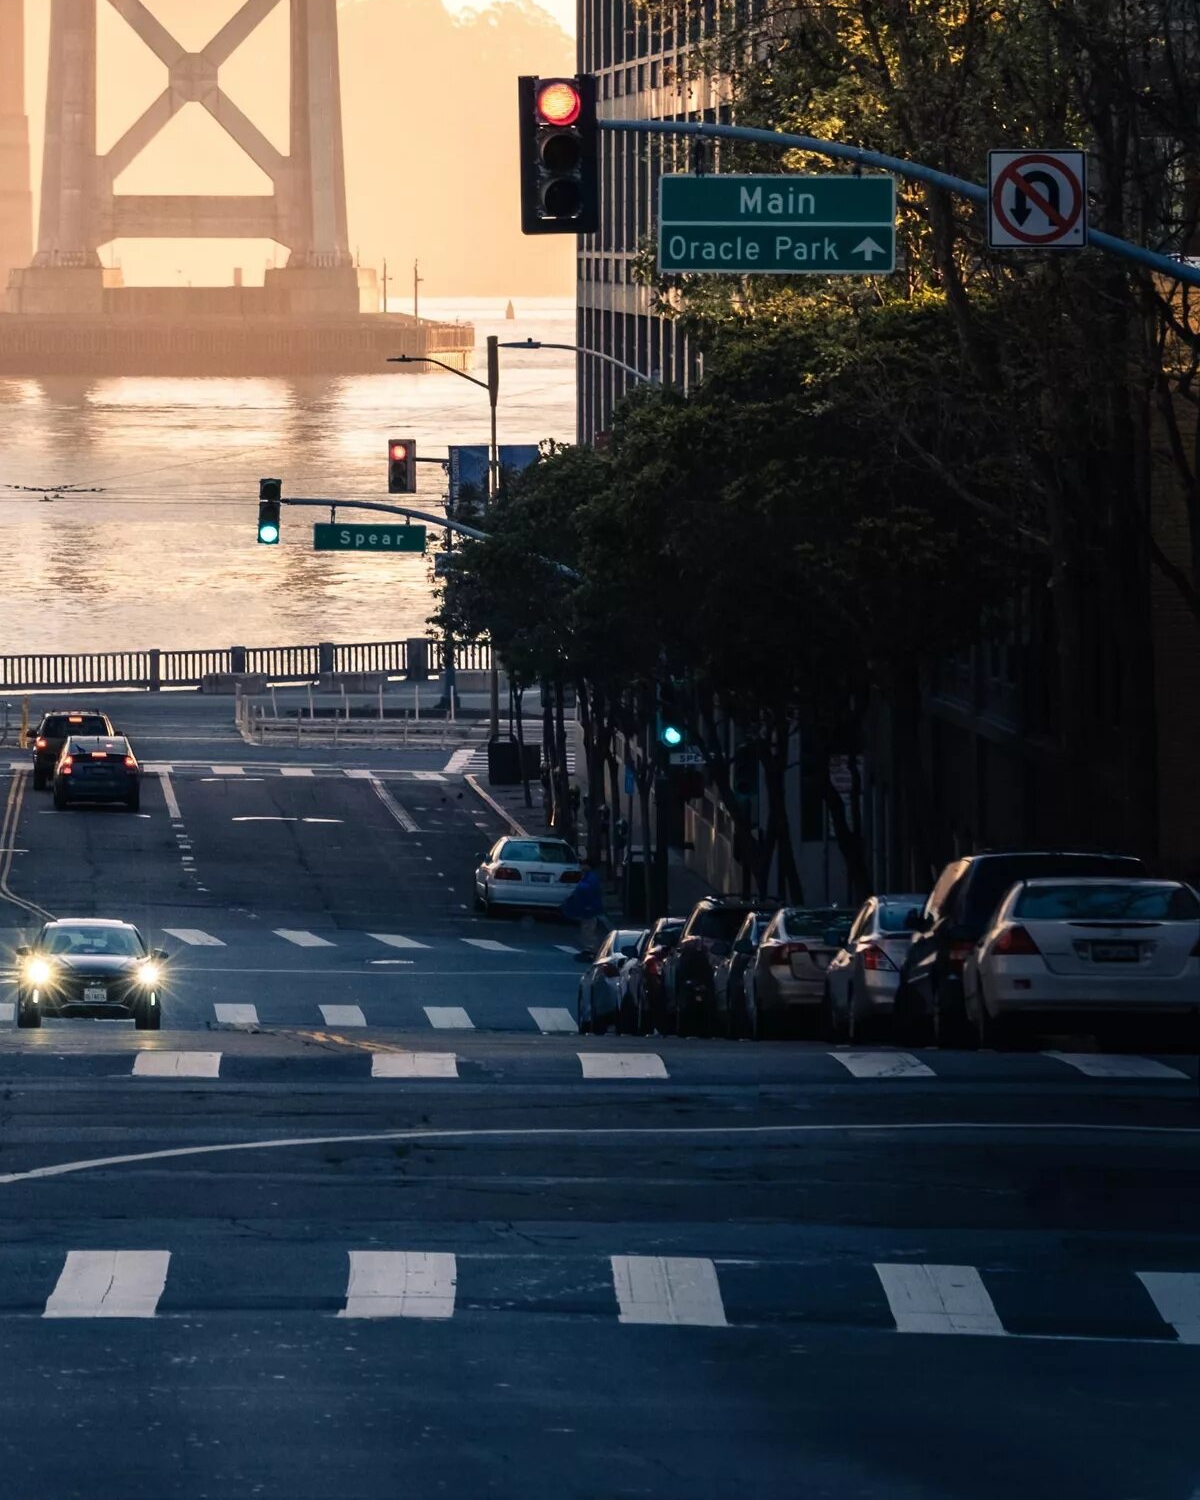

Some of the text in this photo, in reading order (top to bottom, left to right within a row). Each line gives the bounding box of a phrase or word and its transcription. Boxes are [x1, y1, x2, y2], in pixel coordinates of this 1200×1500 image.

[740, 186, 815, 215] Main
[669, 235, 840, 261] Oracle Park
[339, 530, 405, 547] Spear
